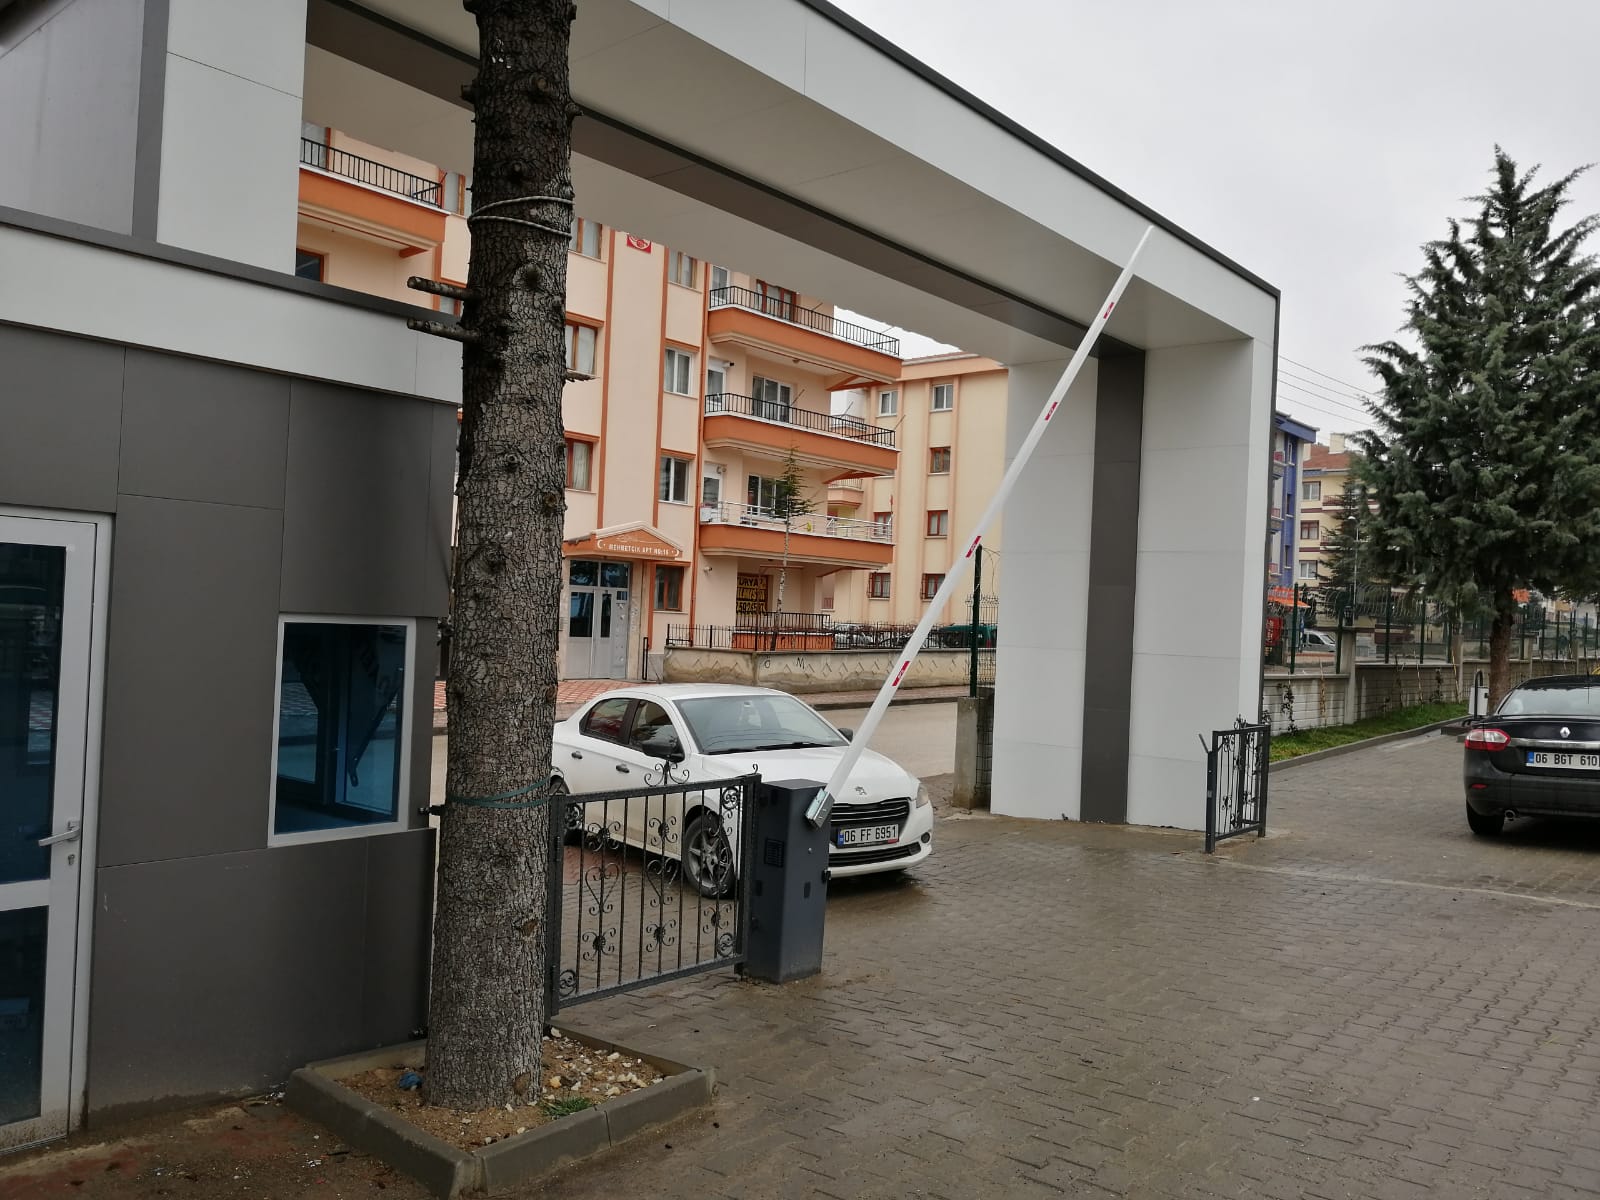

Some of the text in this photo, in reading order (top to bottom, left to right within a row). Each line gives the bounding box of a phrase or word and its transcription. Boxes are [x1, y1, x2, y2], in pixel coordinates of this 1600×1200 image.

[1535, 753, 1598, 766] 06 BGT 610
[844, 825, 896, 842] 06 FF 6951
